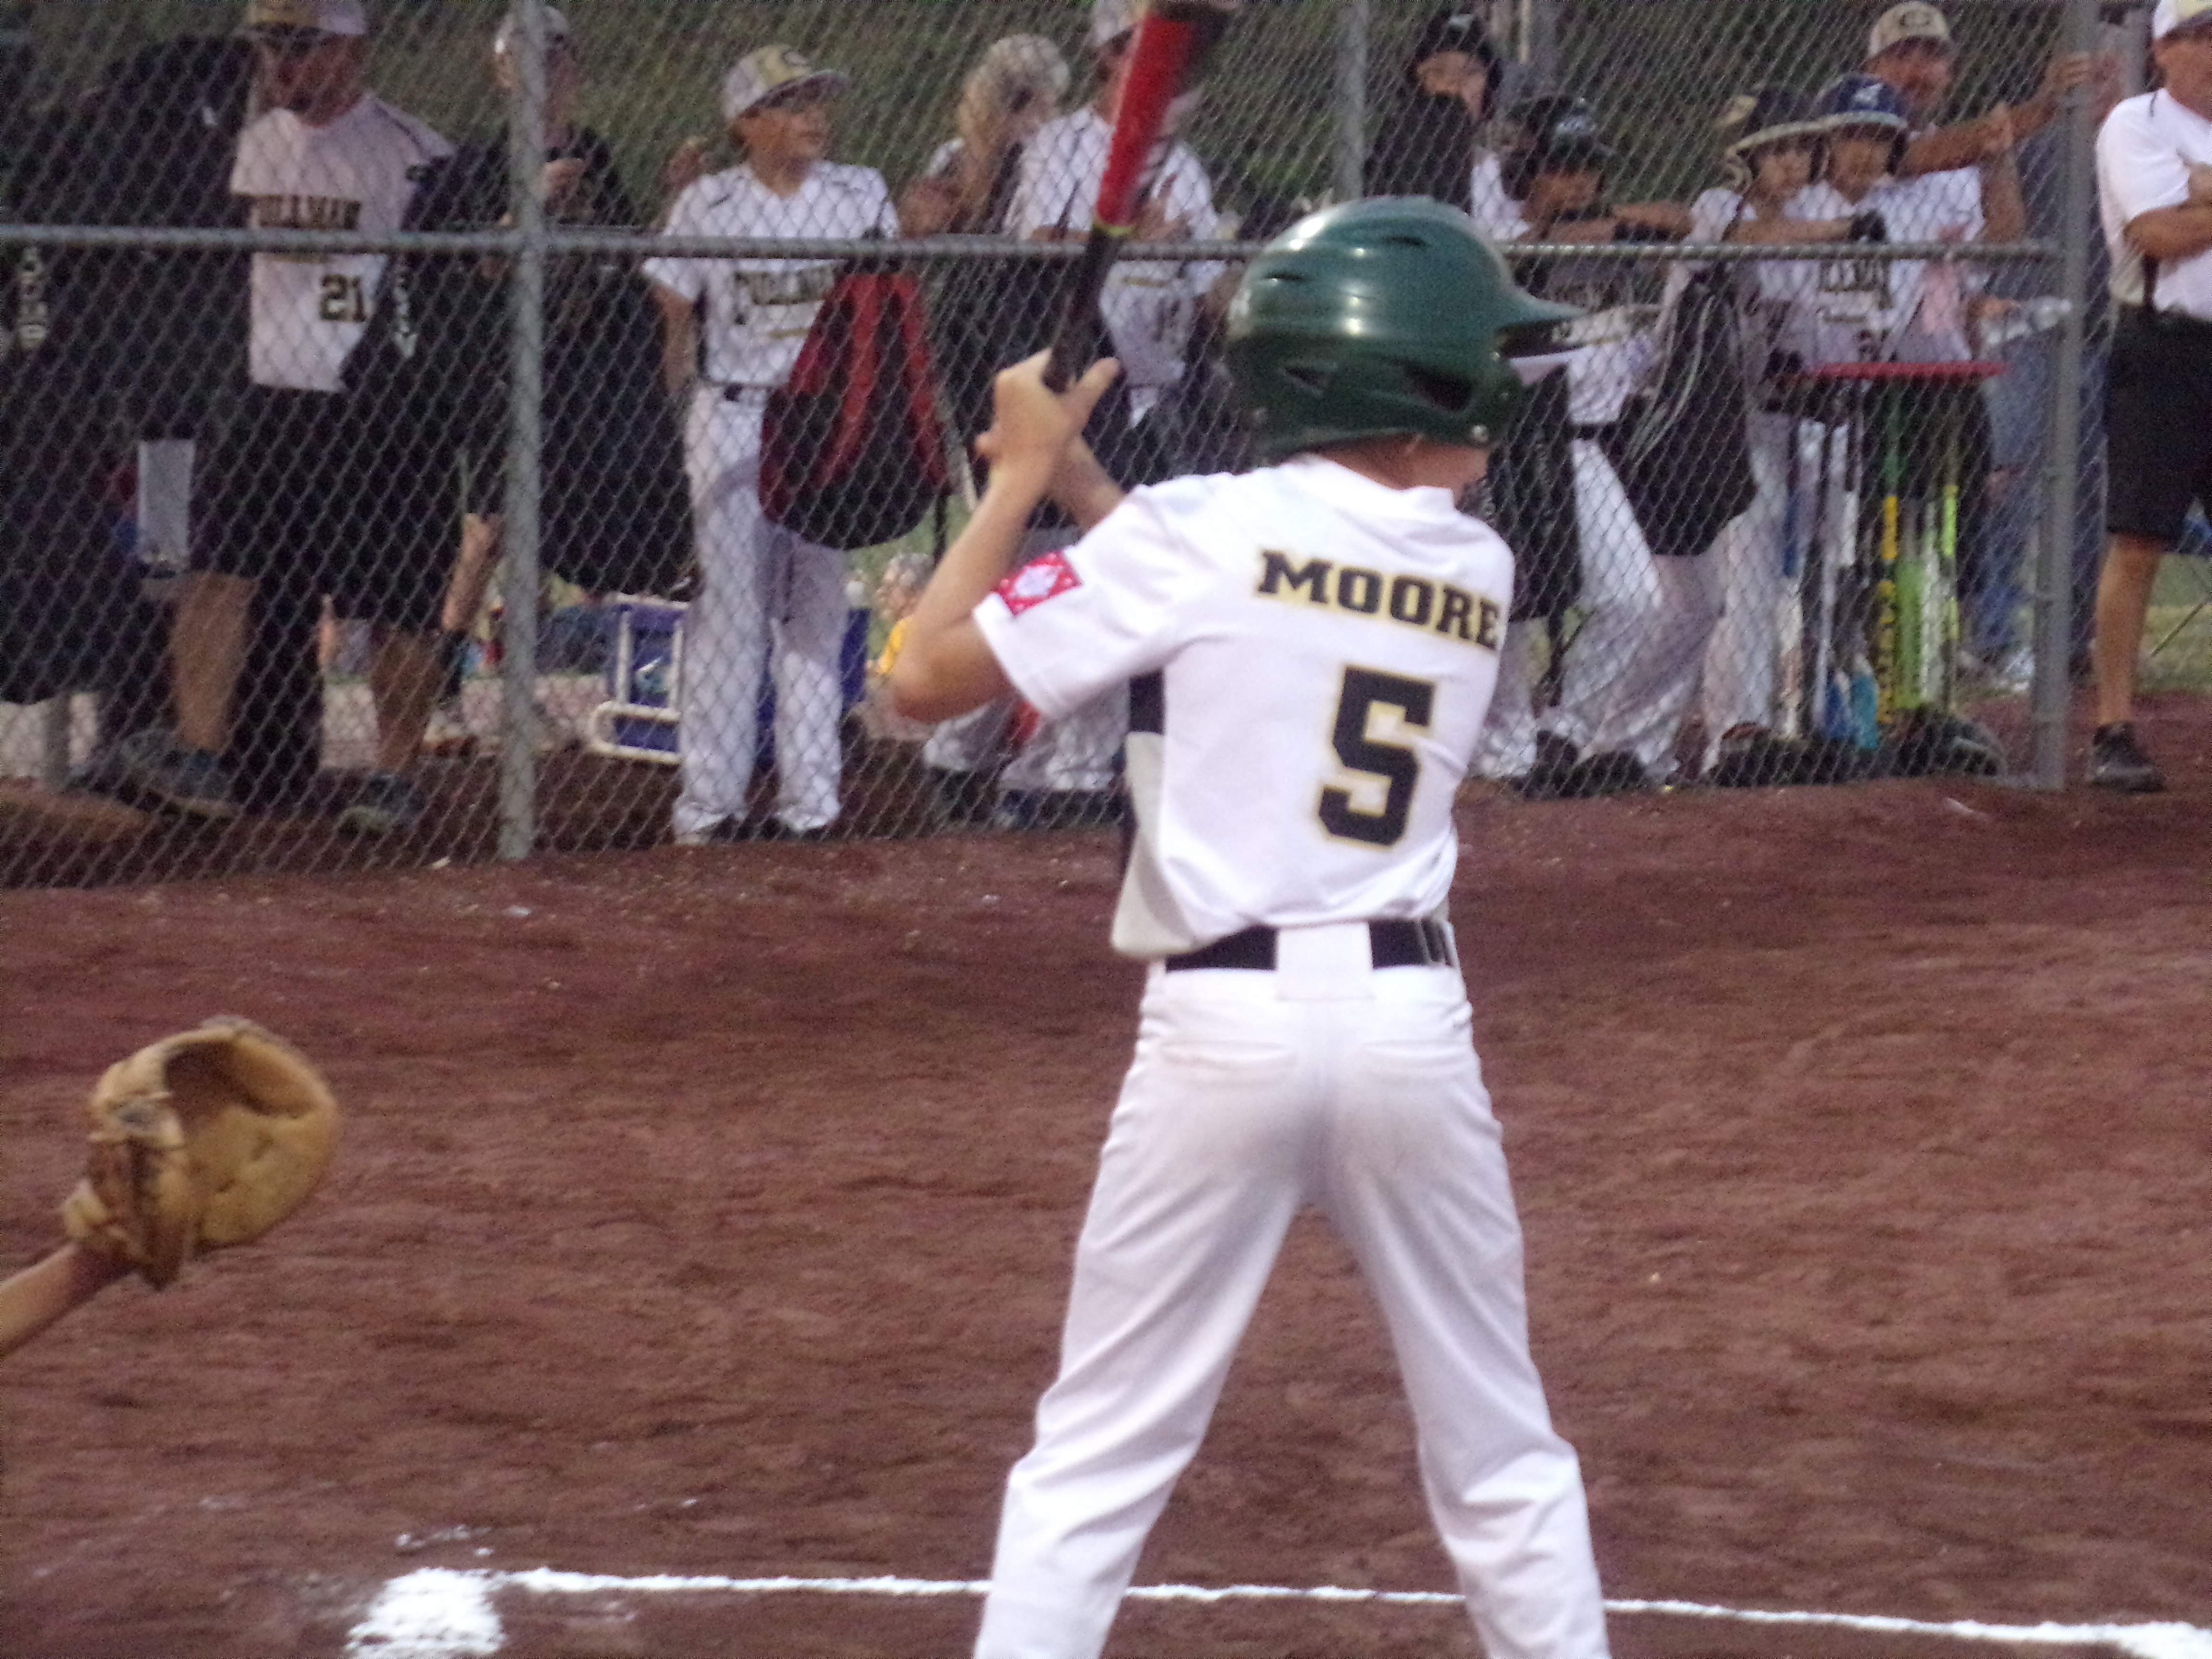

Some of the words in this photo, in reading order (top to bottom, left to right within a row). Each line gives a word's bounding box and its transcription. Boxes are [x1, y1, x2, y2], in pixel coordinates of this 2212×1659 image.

[318, 274, 367, 323] 21
[1255, 548, 1501, 651] MOORE
[1315, 663, 1436, 850] 5
